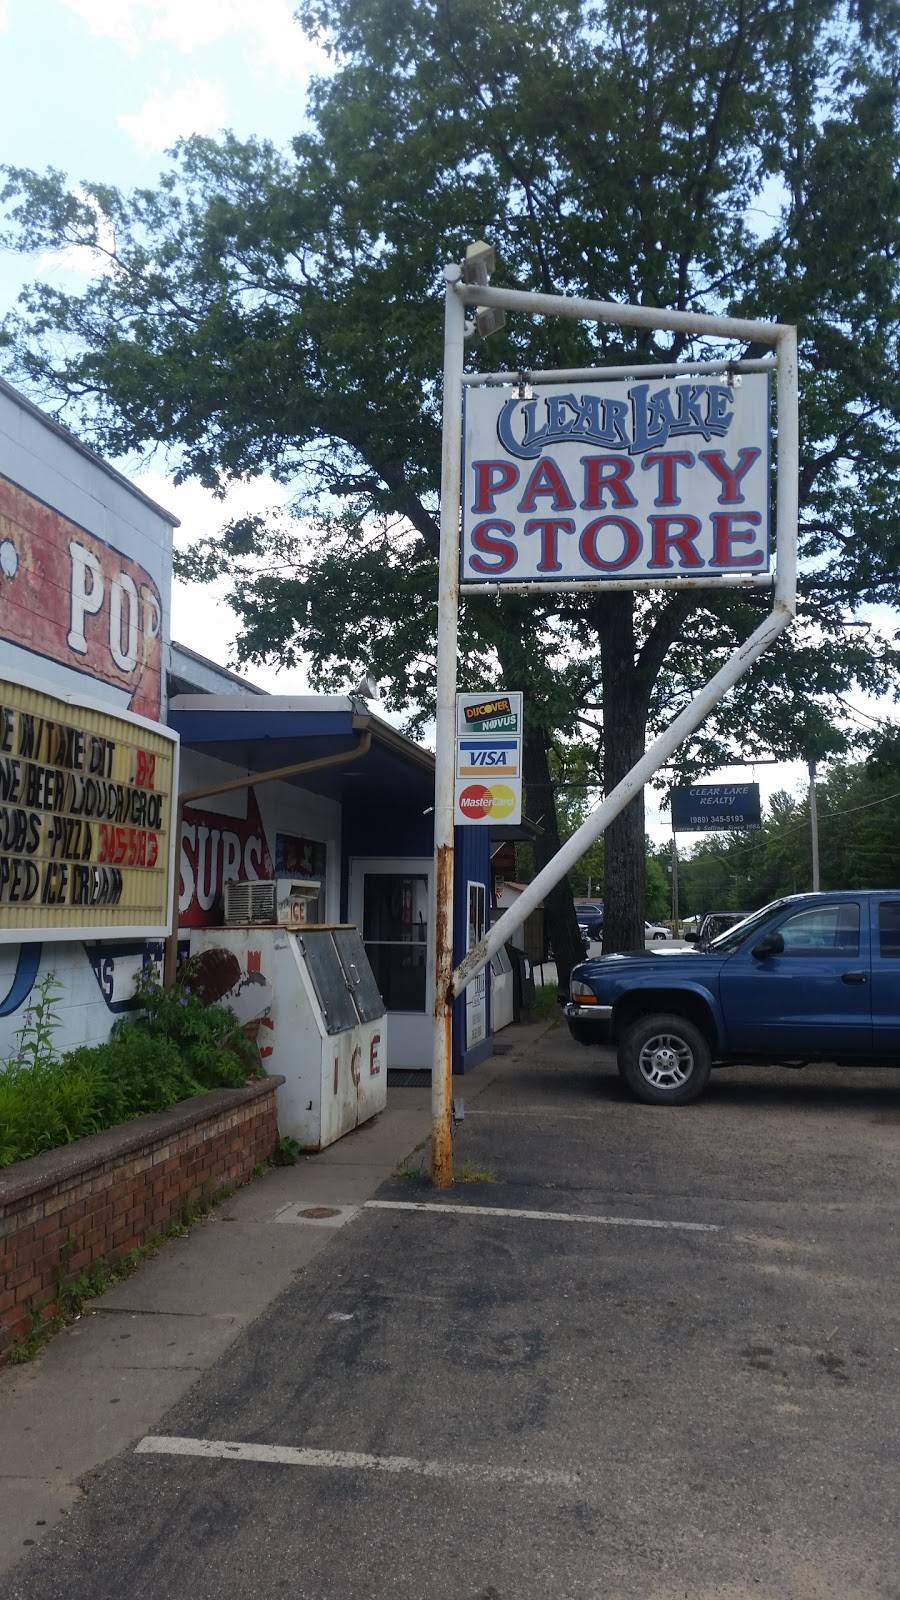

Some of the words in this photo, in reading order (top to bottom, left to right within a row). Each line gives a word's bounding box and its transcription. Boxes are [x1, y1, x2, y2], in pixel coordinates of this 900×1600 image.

[497, 393, 629, 460] CLEAR
[628, 383, 734, 455] LAKE
[471, 447, 762, 514] PARTY
[469, 511, 764, 575] STORE
[66, 541, 161, 675] POP
[466, 700, 510, 718] DISCOVER
[482, 715, 517, 731] NOVUS
[469, 751, 508, 766] VISA
[689, 788, 720, 796] CLEAR
[724, 786, 749, 795] LAKE
[700, 796, 736, 805] REALTY
[461, 797, 512, 808] MasterCard
[690, 815, 709, 824] (989)
[710, 814, 744, 823] 345-5193
[178, 820, 262, 912] SUBS
[290, 901, 305, 921] ICE
[333, 1034, 381, 1095] ICE
